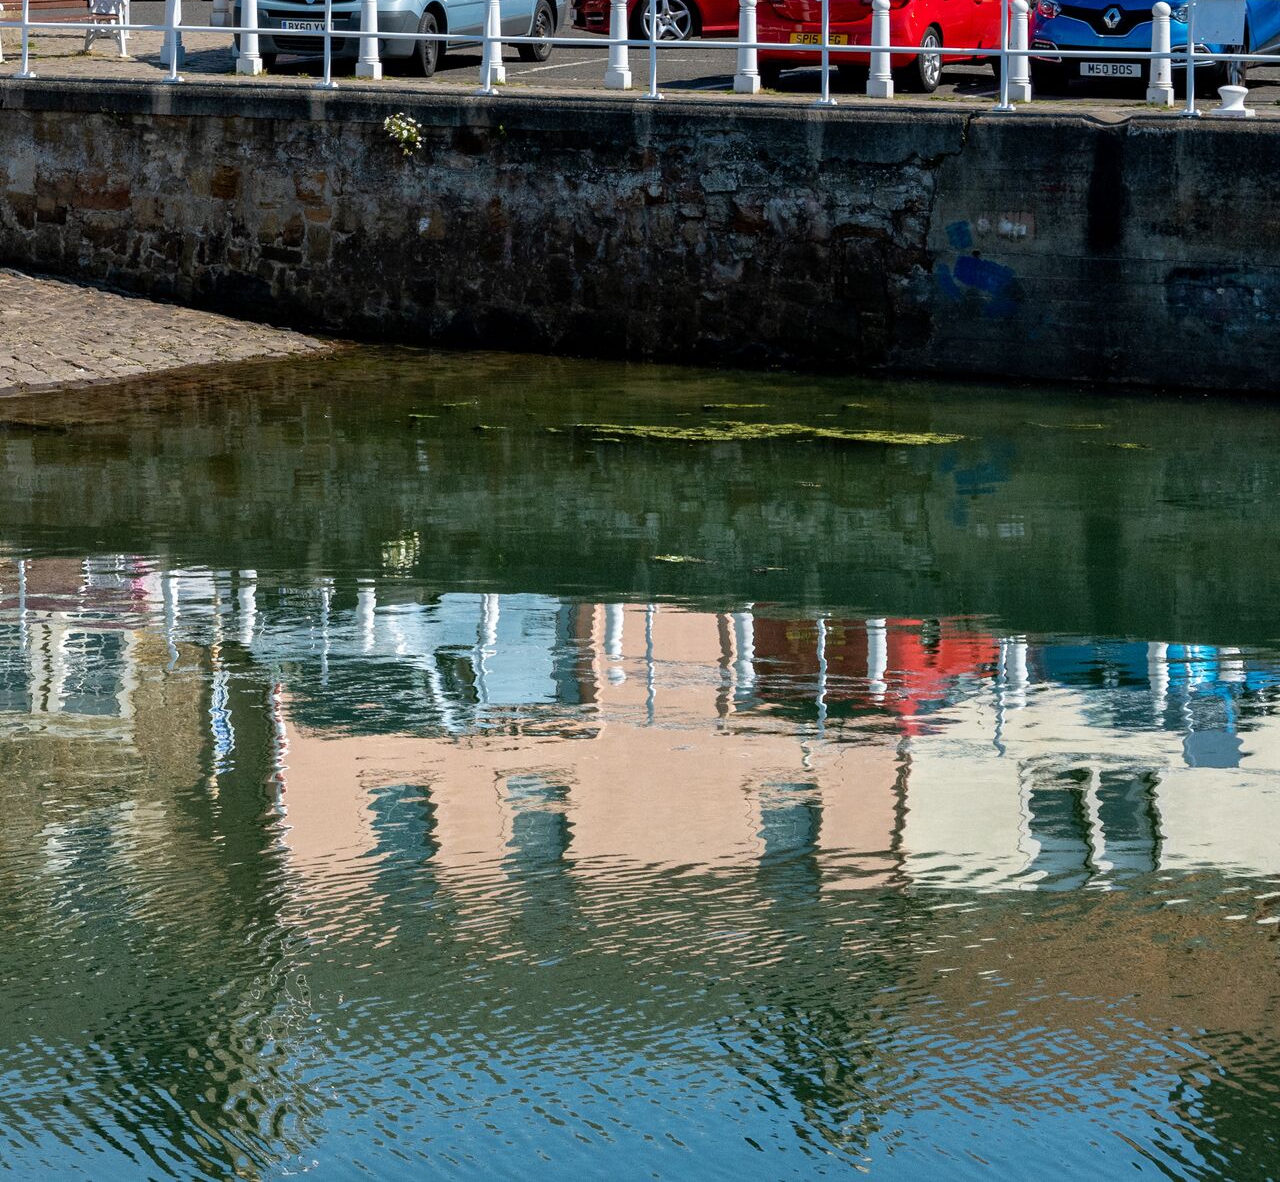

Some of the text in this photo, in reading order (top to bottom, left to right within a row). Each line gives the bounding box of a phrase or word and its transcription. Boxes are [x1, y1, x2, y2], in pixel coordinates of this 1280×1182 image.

[796, 34, 818, 44] SP15
[1088, 64, 1134, 75] M50 BOS
